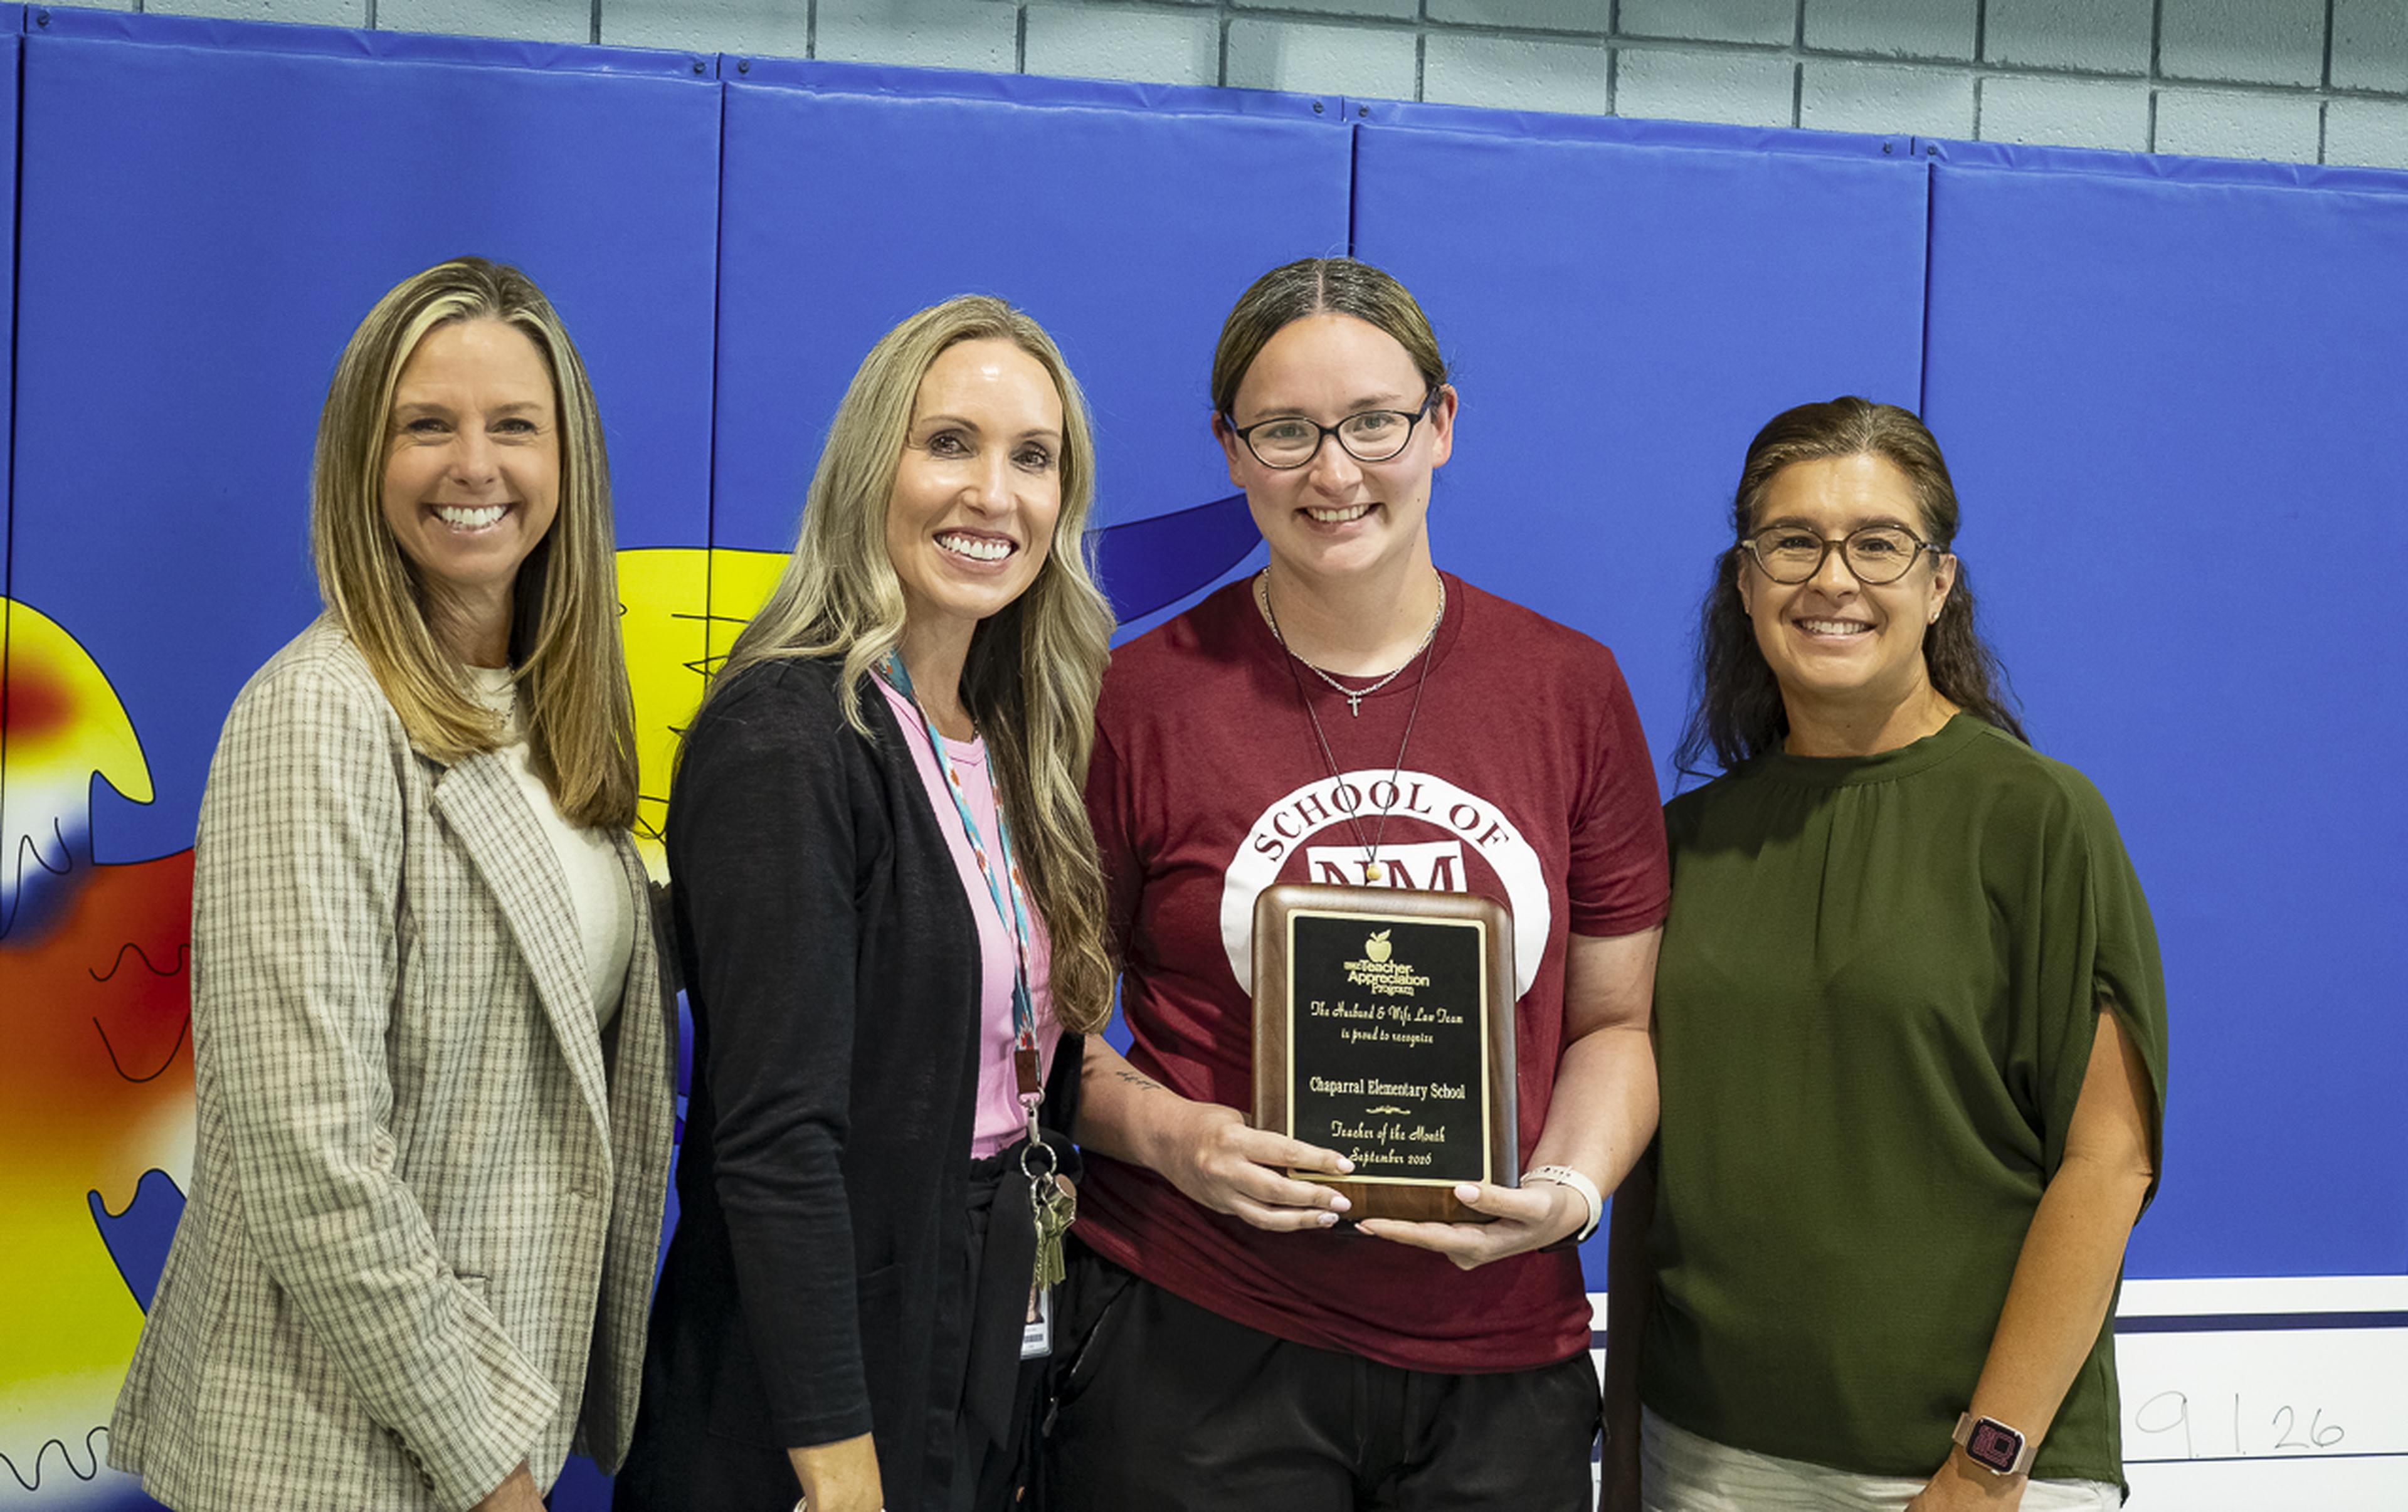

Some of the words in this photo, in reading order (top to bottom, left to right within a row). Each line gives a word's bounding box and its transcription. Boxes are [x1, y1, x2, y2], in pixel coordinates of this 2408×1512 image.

[1254, 780, 1432, 862] SCHOOL
[1449, 804, 1509, 849] OF
[1347, 970, 1430, 987] Appreciation
[1371, 983, 1415, 997] Program
[1311, 1001, 1329, 1017] The
[1332, 1001, 1374, 1019] Husband
[1376, 1006, 1385, 1020] &
[1388, 1005, 1411, 1027] Wife
[1414, 1007, 1435, 1022] Law
[1437, 1007, 1464, 1023] Team
[1341, 1028, 1349, 1039] is
[1351, 1026, 1378, 1044] proud
[1380, 1029, 1389, 1040] to
[1309, 1076, 1365, 1096] Chaparral
[1368, 1079, 1428, 1101] Elementary
[1430, 1082, 1465, 1099] School
[1331, 1120, 1373, 1139] Teacher
[1377, 1122, 1388, 1146] of
[1390, 1123, 1405, 1140] the
[1408, 1126, 1445, 1142] Month
[1348, 1147, 1403, 1167] September
[1408, 1152, 1432, 1165] 2026
